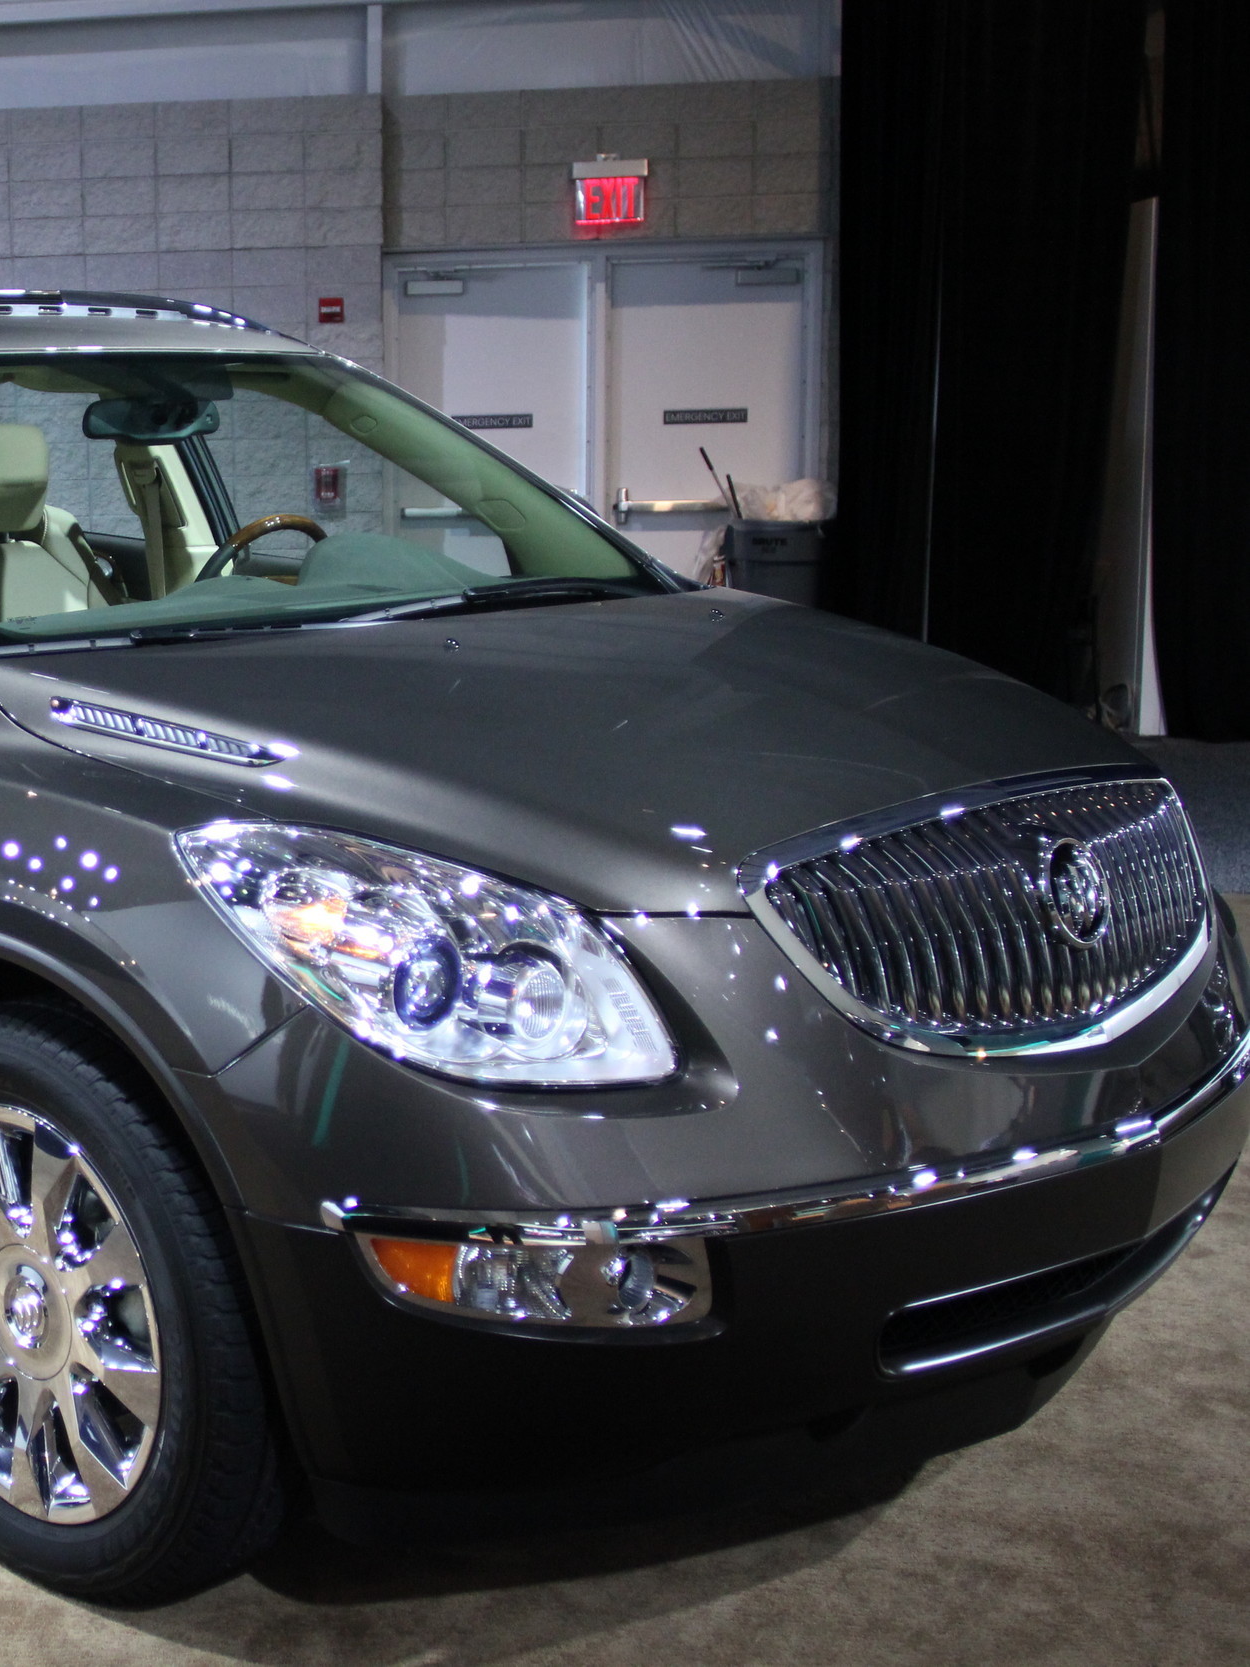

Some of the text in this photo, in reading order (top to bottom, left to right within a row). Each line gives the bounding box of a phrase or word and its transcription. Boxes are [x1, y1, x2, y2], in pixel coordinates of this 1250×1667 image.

[584, 177, 639, 219] EXIT
[454, 416, 531, 427] MERGENCY EXIT
[665, 410, 745, 423] EMERGENCY EXIT
[752, 537, 788, 546] BRUTE
